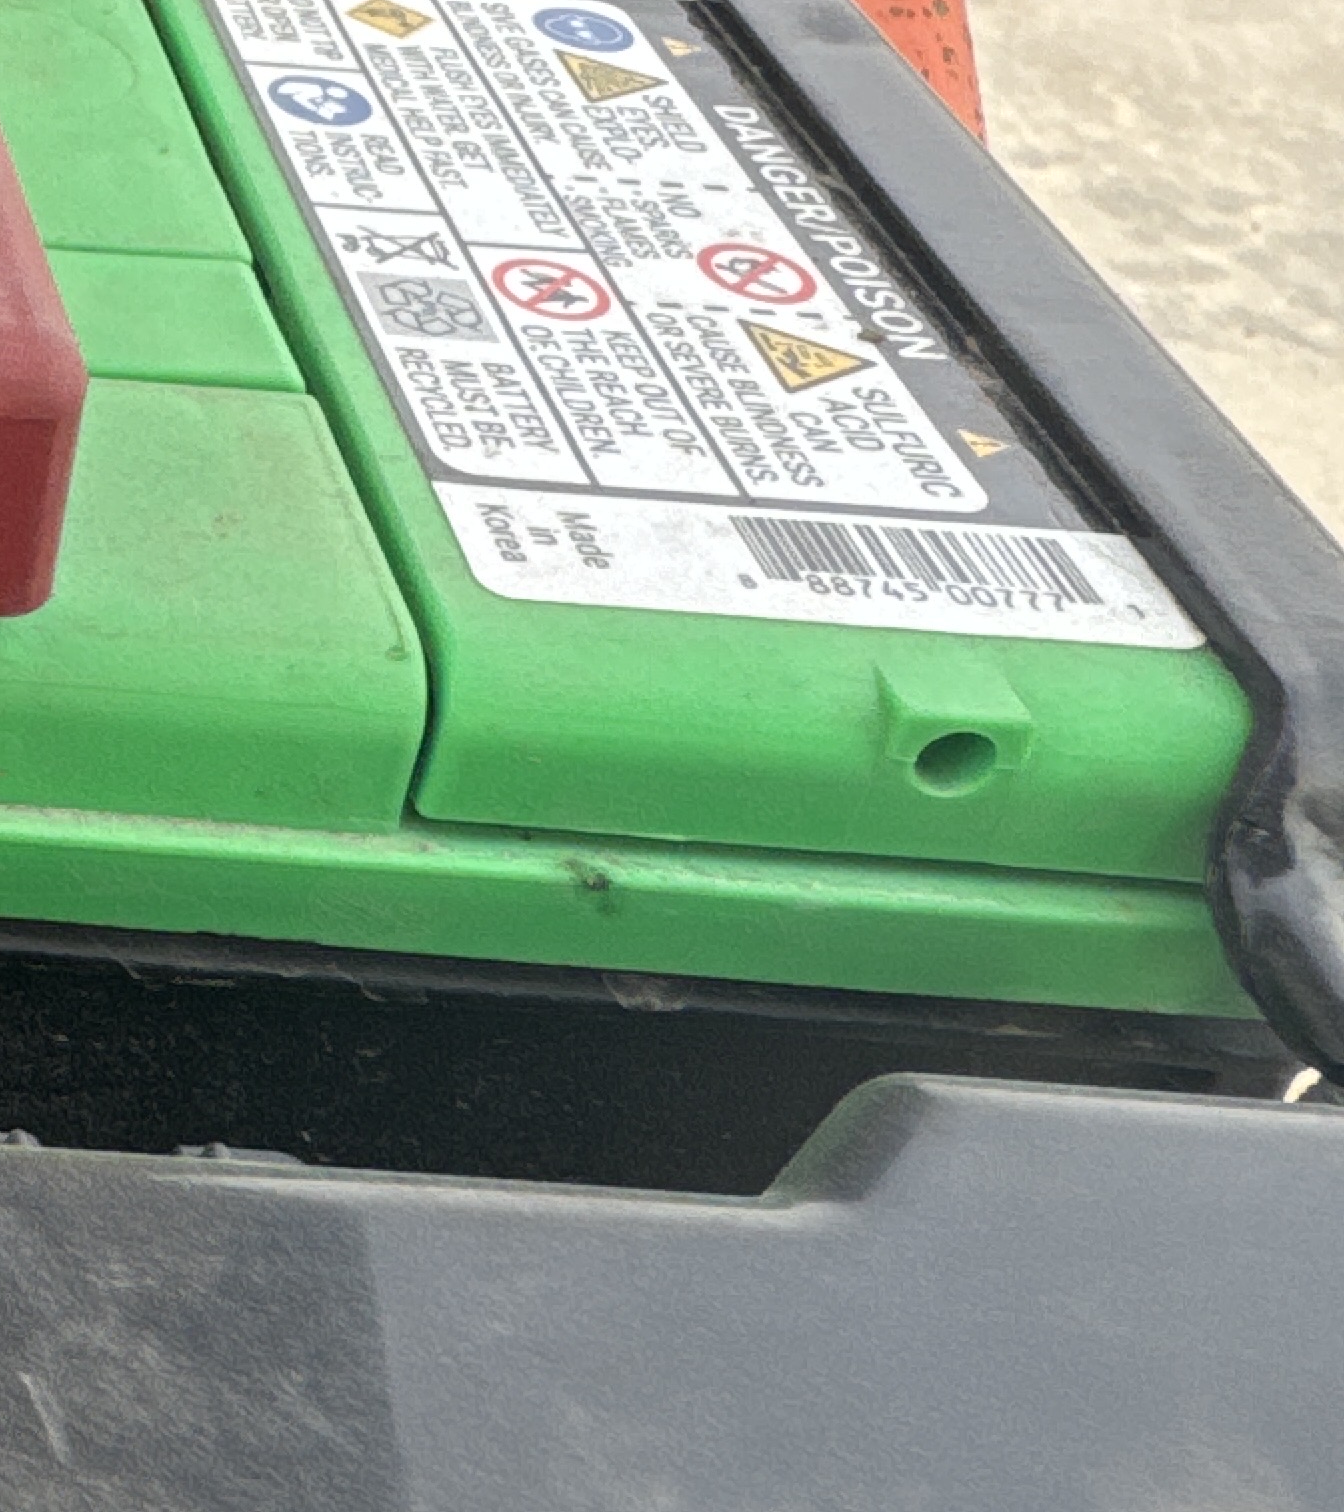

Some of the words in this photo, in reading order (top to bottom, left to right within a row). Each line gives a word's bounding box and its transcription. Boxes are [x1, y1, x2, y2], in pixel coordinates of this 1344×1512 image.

[444, 0, 512, 69] BLINDNESS
[490, 71, 527, 91] OR
[478, 2, 527, 34] SIVE
[428, 46, 479, 90] FLUSH
[456, 94, 504, 130] EYES
[501, 36, 563, 87] GASES
[361, 43, 421, 104] MEDICAL
[397, 107, 445, 147] HELP
[394, 44, 440, 80] WITH
[449, 140, 495, 172] GET
[535, 88, 581, 119] CAN
[639, 94, 711, 153] SHIELD
[357, 134, 408, 176] READ
[556, 121, 615, 171] CAUSE
[561, 194, 634, 267] SMOKING
[595, 196, 662, 260] FLAMES
[627, 198, 695, 260] SPARKS
[657, 193, 704, 219] NO
[709, 104, 950, 361] DANGER/POISON
[517, 324, 562, 350] OF
[558, 327, 612, 365] THE
[599, 330, 659, 378] KEEP
[643, 312, 687, 338] OR
[392, 346, 479, 454] RECYCLED.
[438, 359, 501, 418] MUST
[584, 369, 655, 437] REACH
[631, 383, 686, 424] OUT
[661, 339, 735, 411] SEVERE
[683, 315, 750, 373] CAUSE
[724, 378, 827, 488] BLINDNESS
[470, 420, 517, 449] BE
[480, 362, 561, 454] BATTERY
[533, 353, 626, 460] CHILDREN.
[785, 411, 844, 454] CAN
[817, 398, 889, 452] ACID
[658, 427, 707, 457] OF
[708, 416, 785, 487] BURNS.
[848, 386, 964, 498] SULFURIC
[475, 503, 528, 563] Korea
[526, 526, 562, 546] in
[556, 511, 614, 569] Made
[806, 573, 929, 603] 88745
[945, 583, 1065, 612] 00777
